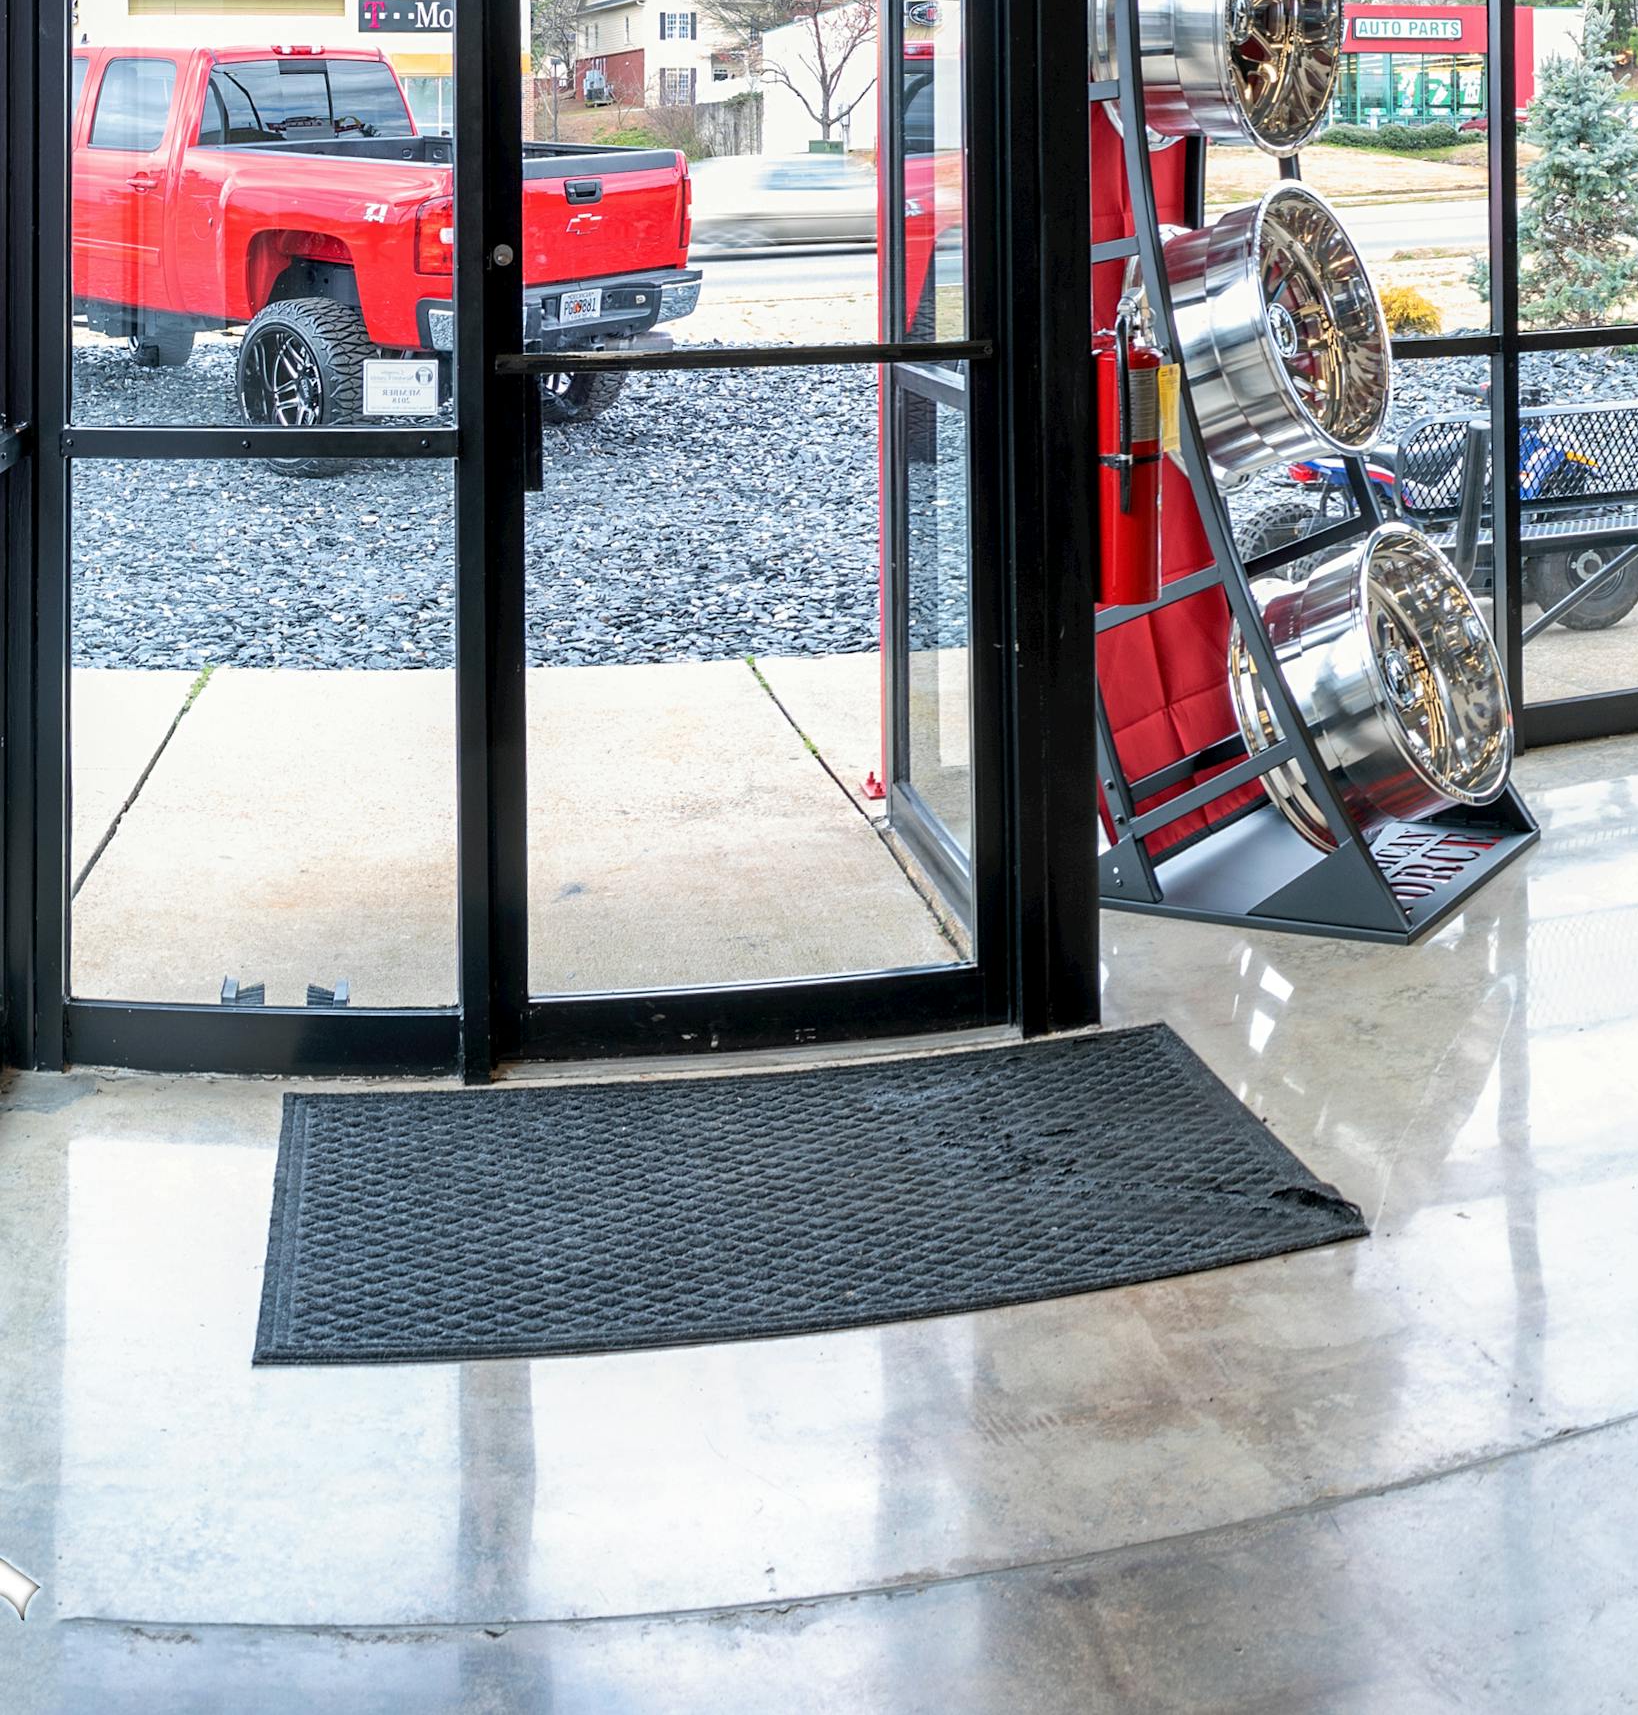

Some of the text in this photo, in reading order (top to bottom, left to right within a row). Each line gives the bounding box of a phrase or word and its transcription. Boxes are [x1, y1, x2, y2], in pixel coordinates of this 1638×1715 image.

[1358, 21, 1401, 36] AUTO
[1408, 21, 1460, 37] PARTS
[1390, 833, 1506, 901] ORCE
